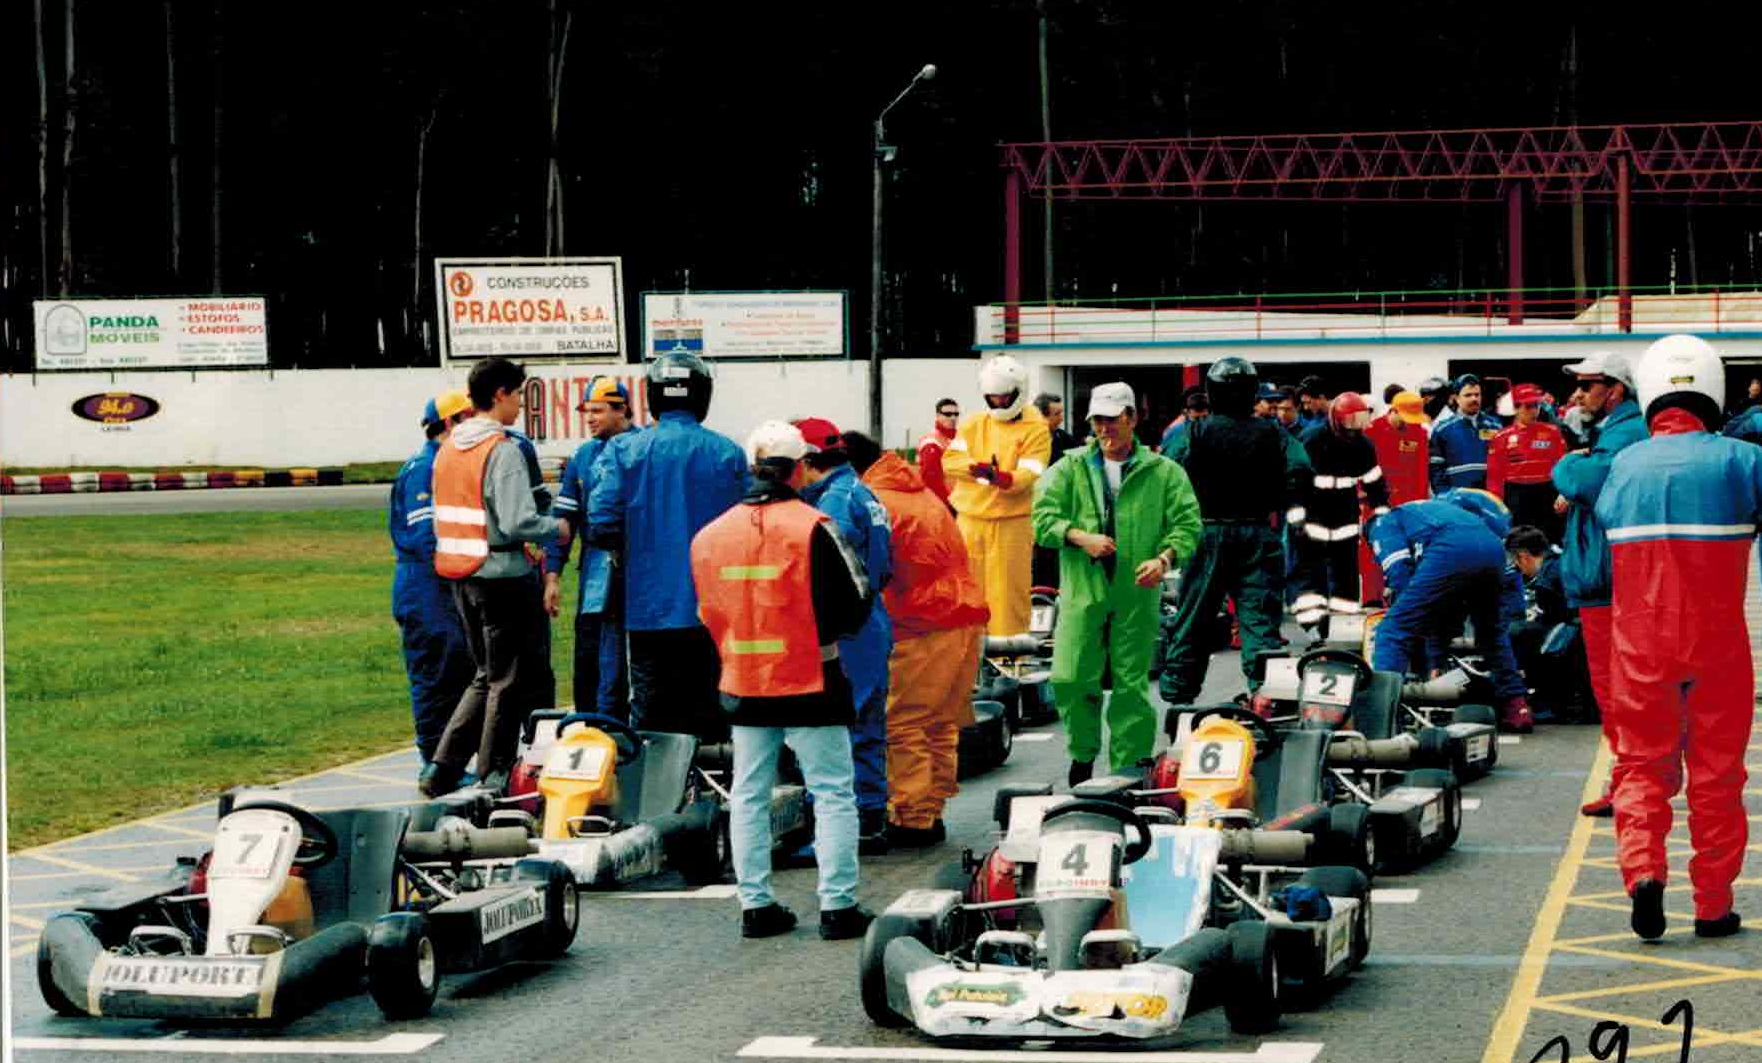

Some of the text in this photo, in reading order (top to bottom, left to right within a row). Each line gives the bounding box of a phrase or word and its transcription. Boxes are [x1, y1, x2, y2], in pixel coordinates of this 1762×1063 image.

[90, 316, 160, 328] PANDA
[557, 340, 614, 351] BATALHA
[1319, 674, 1337, 697] 2
[569, 748, 583, 770] 1
[1200, 742, 1222, 774] 6
[236, 833, 264, 864] 7
[1061, 844, 1088, 876] 4
